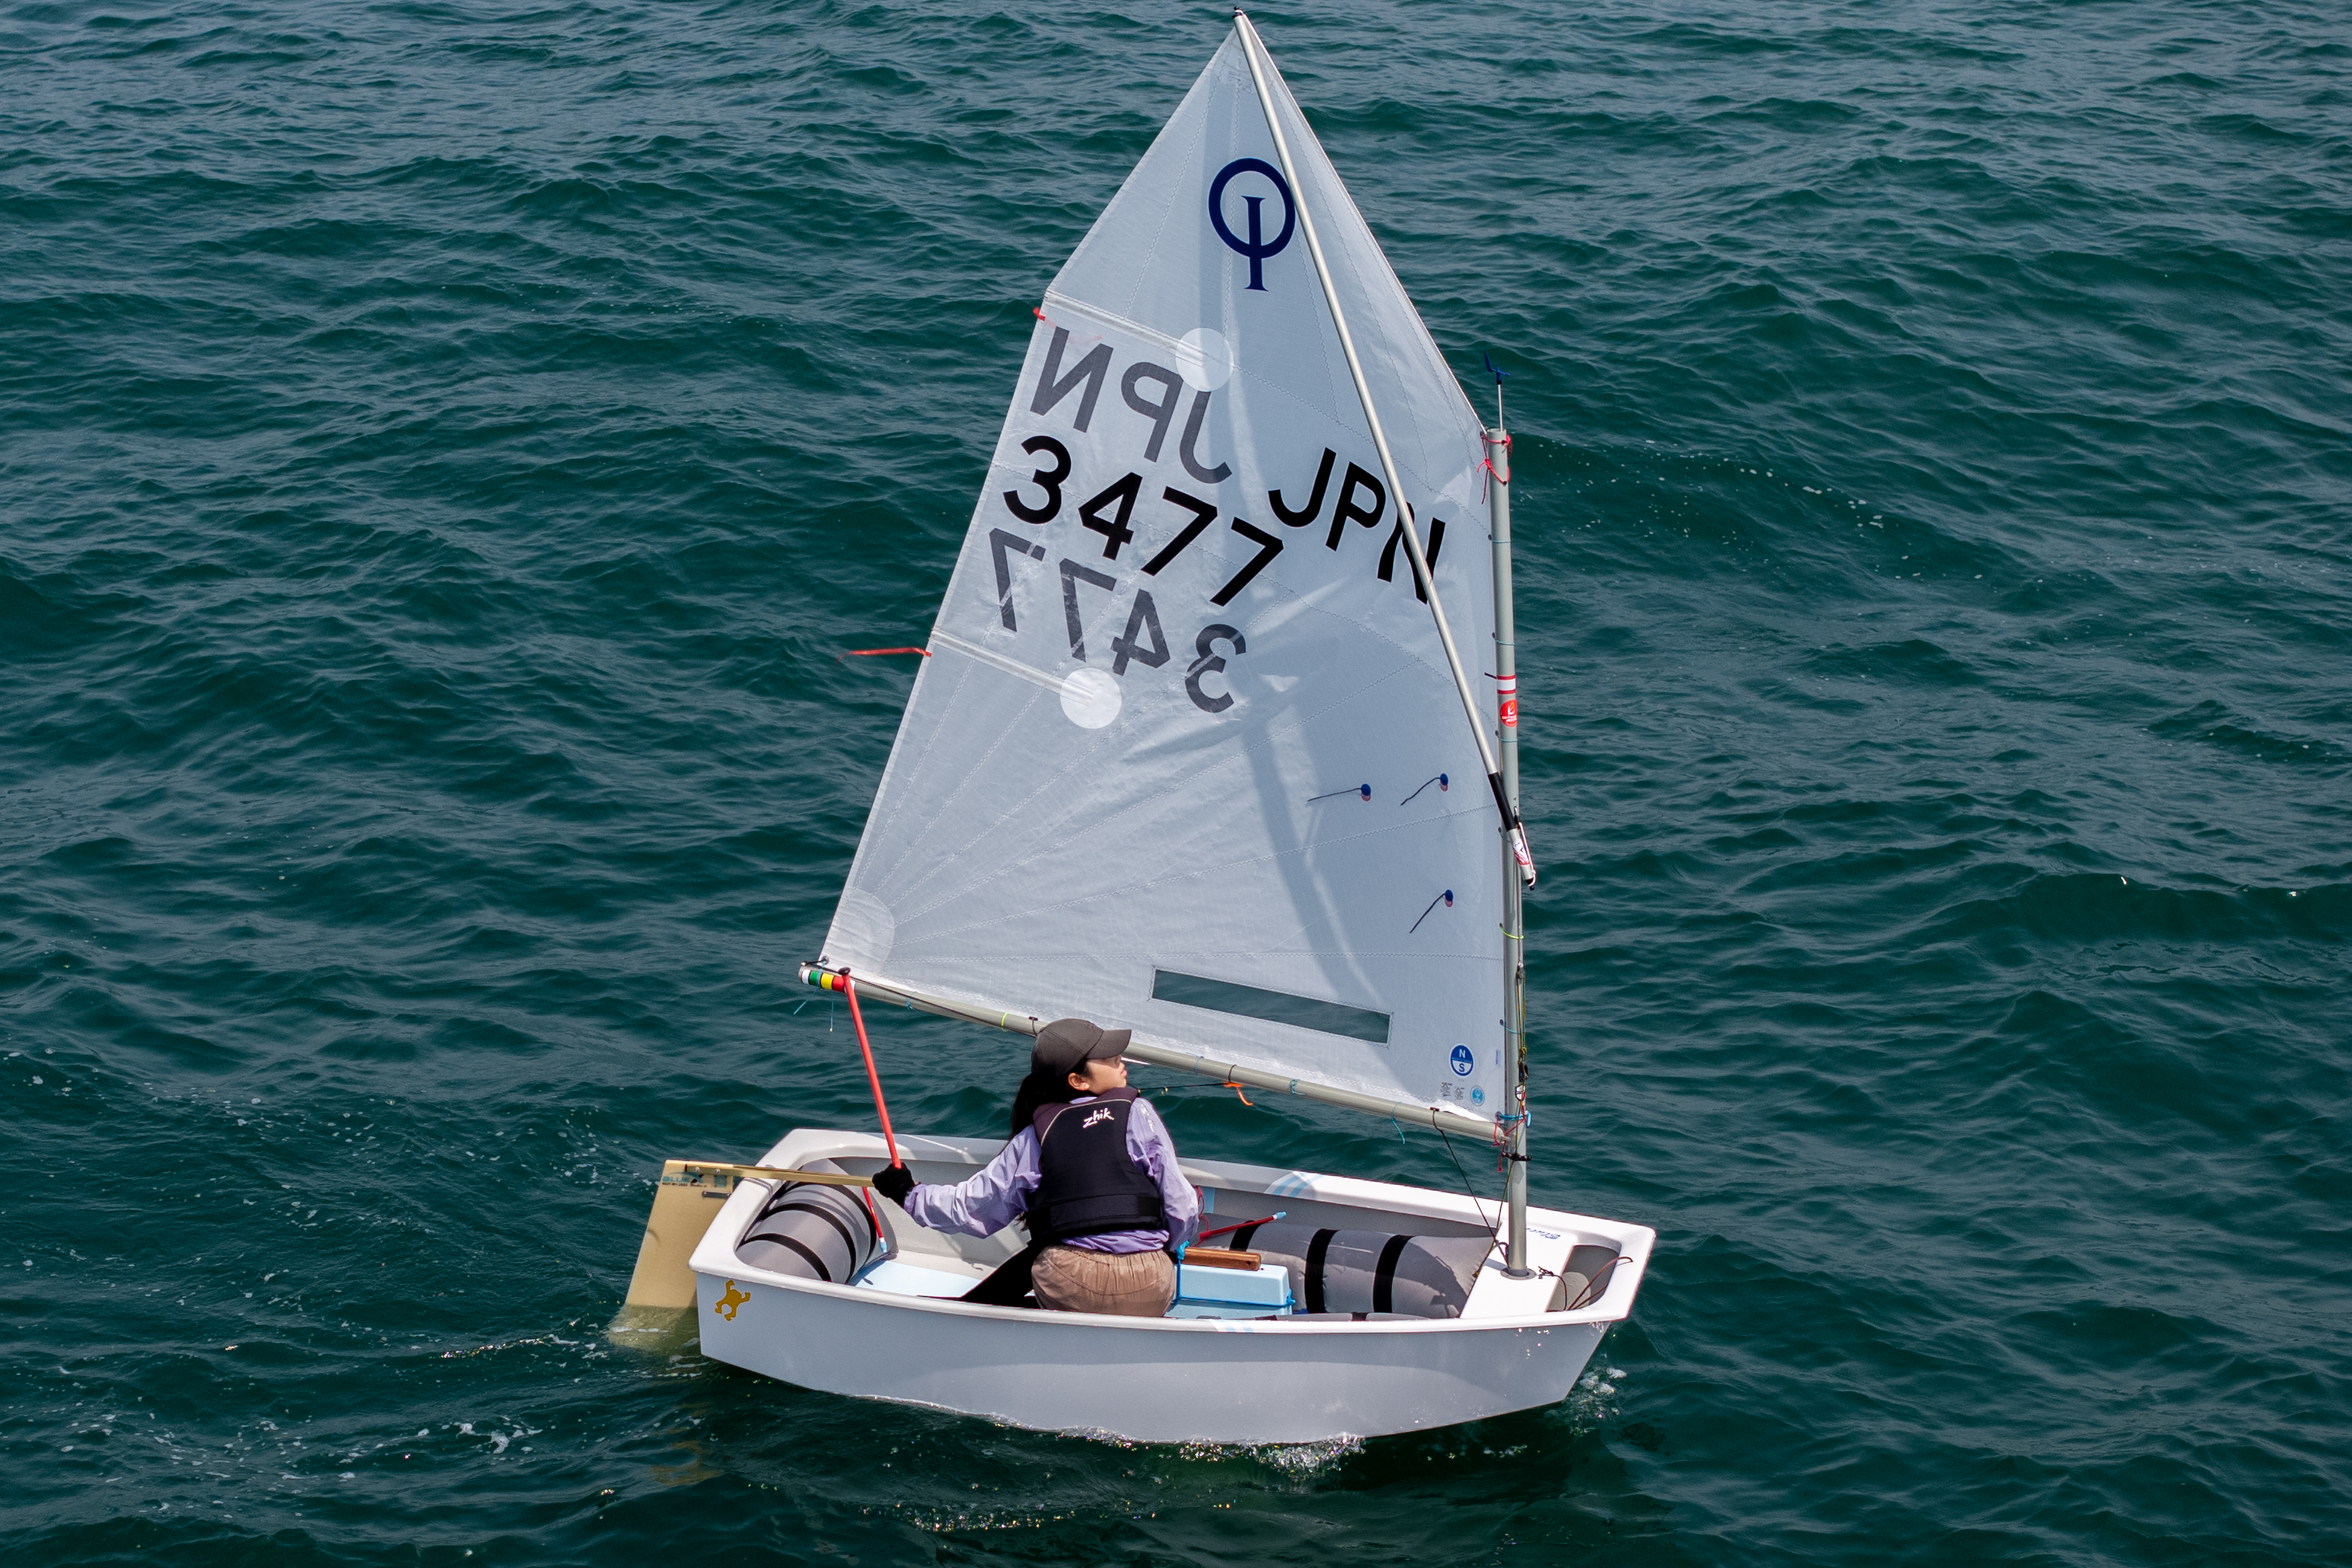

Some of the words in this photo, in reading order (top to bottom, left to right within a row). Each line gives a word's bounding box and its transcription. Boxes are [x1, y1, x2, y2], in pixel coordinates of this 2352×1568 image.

[1002, 435, 1284, 607] 3477
[1267, 446, 1446, 605] JPN
[1458, 1063, 1465, 1072] S
[1459, 1048, 1466, 1058] N
